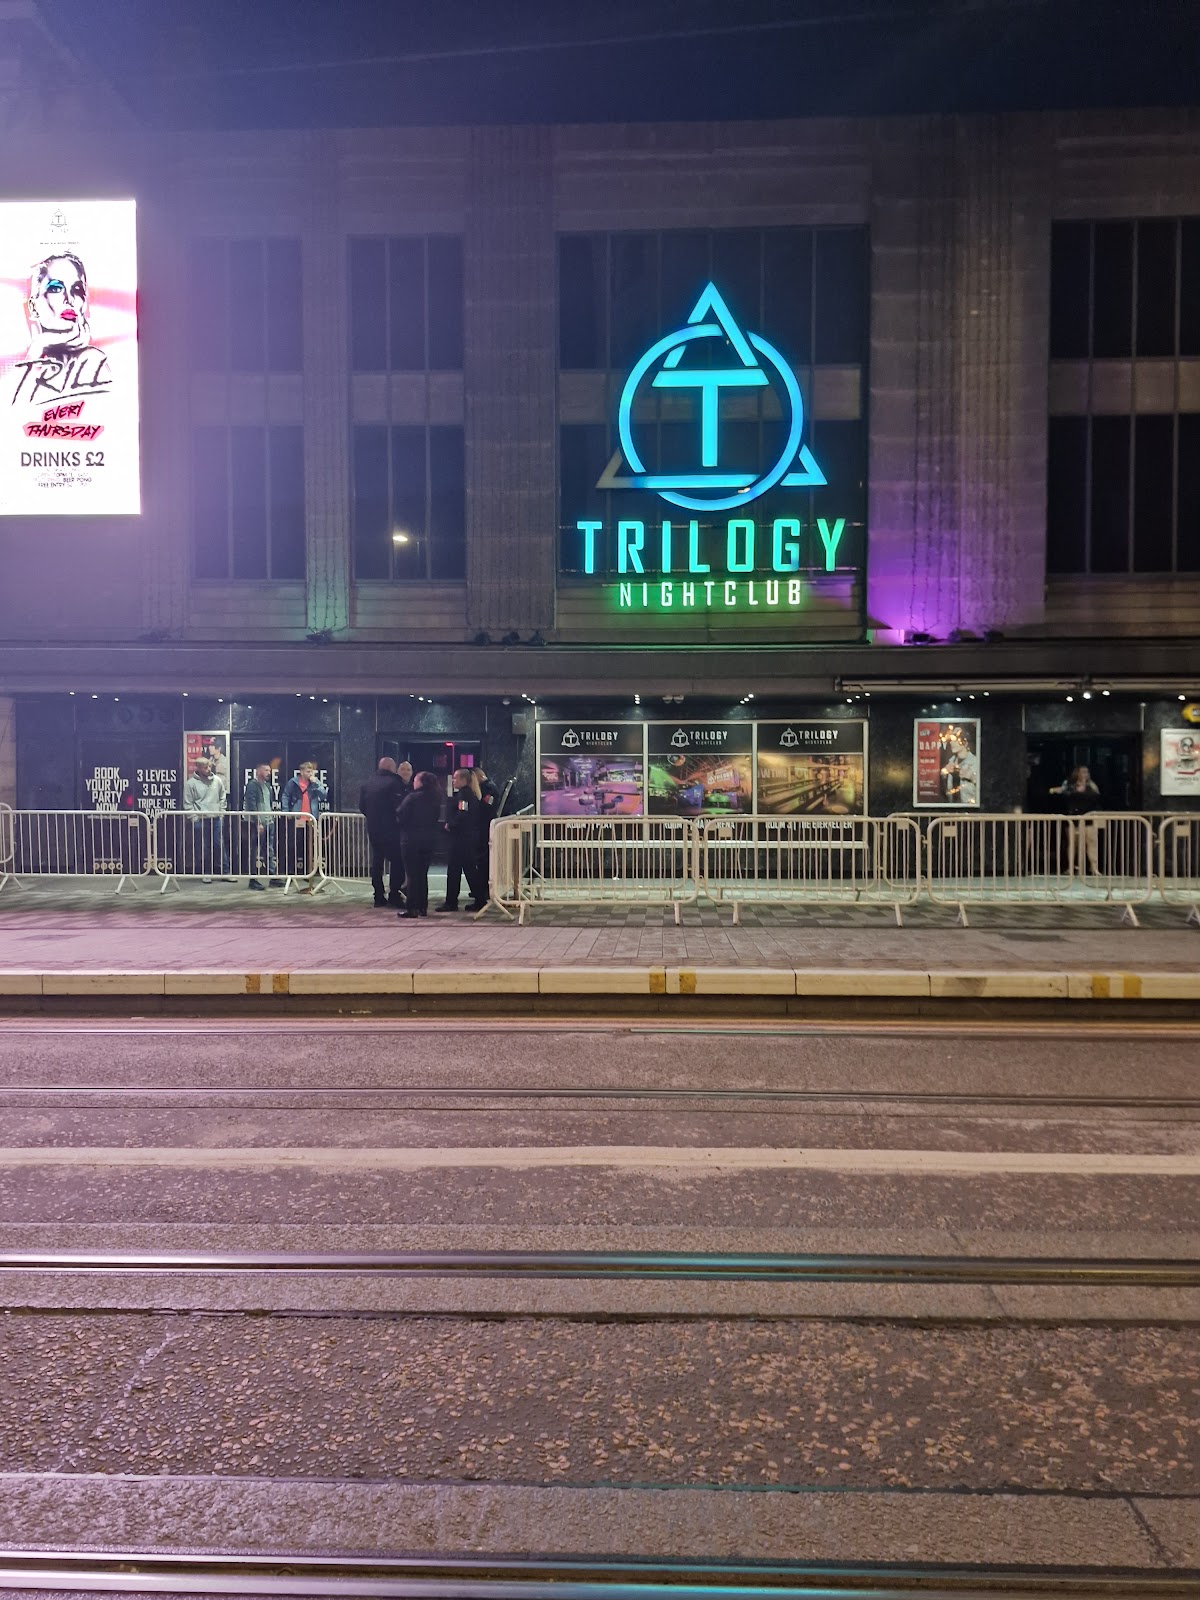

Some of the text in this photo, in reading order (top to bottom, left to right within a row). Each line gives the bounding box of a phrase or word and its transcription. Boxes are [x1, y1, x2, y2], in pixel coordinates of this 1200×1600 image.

[12, 356, 113, 406] TRILL
[44, 401, 85, 422] EVERY
[27, 424, 101, 440] THURSDAY
[20, 451, 105, 467] DRINKS £2
[577, 518, 846, 574] TRILOGY
[619, 579, 801, 607] NIGHTCLUB
[580, 731, 619, 741] TRILOGY
[689, 730, 728, 740] TRILOGY
[799, 729, 838, 740] TRILOGY
[919, 741, 947, 751] DAPPY
[94, 767, 120, 780] BOOK
[137, 769, 177, 782] 3 LEVELS
[244, 768, 280, 786] FE
[85, 779, 129, 791] YOUR VIP
[142, 783, 171, 796] 3 DJ'S
[92, 791, 122, 803] PARTY
[137, 798, 176, 809] TRIPLE THE
[96, 803, 118, 812] NOW
